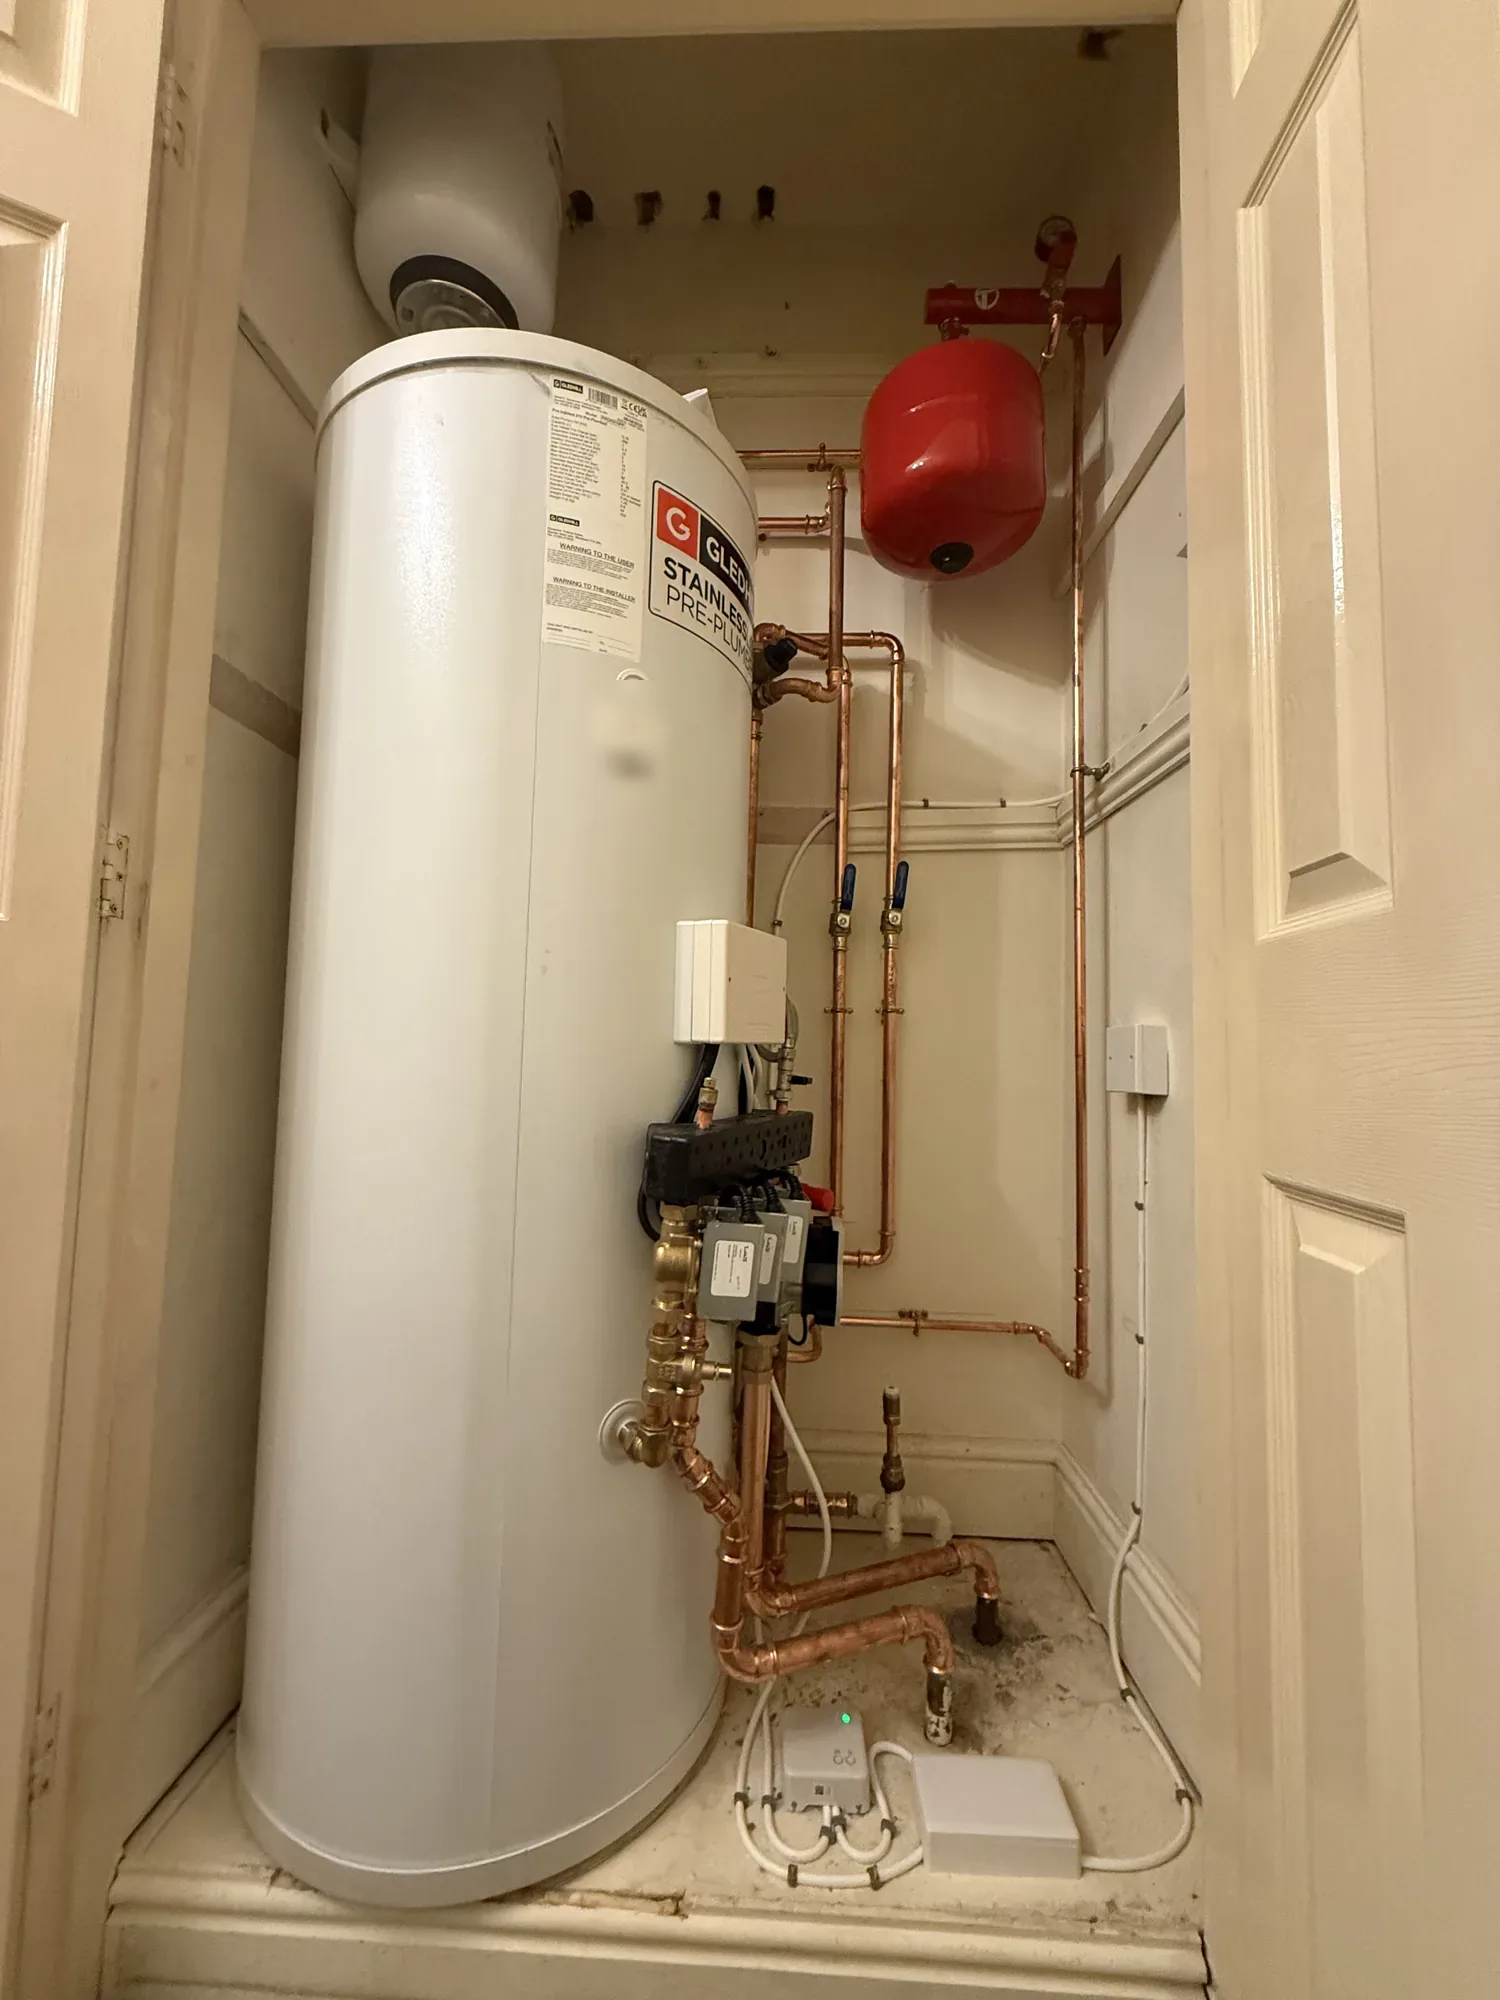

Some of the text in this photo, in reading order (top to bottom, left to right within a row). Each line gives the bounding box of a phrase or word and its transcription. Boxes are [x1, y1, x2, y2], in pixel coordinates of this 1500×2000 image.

[665, 507, 691, 541] G
[559, 542, 635, 569] WARNING TO THE USER
[552, 576, 636, 604] WARNING TO THE INSTALLER
